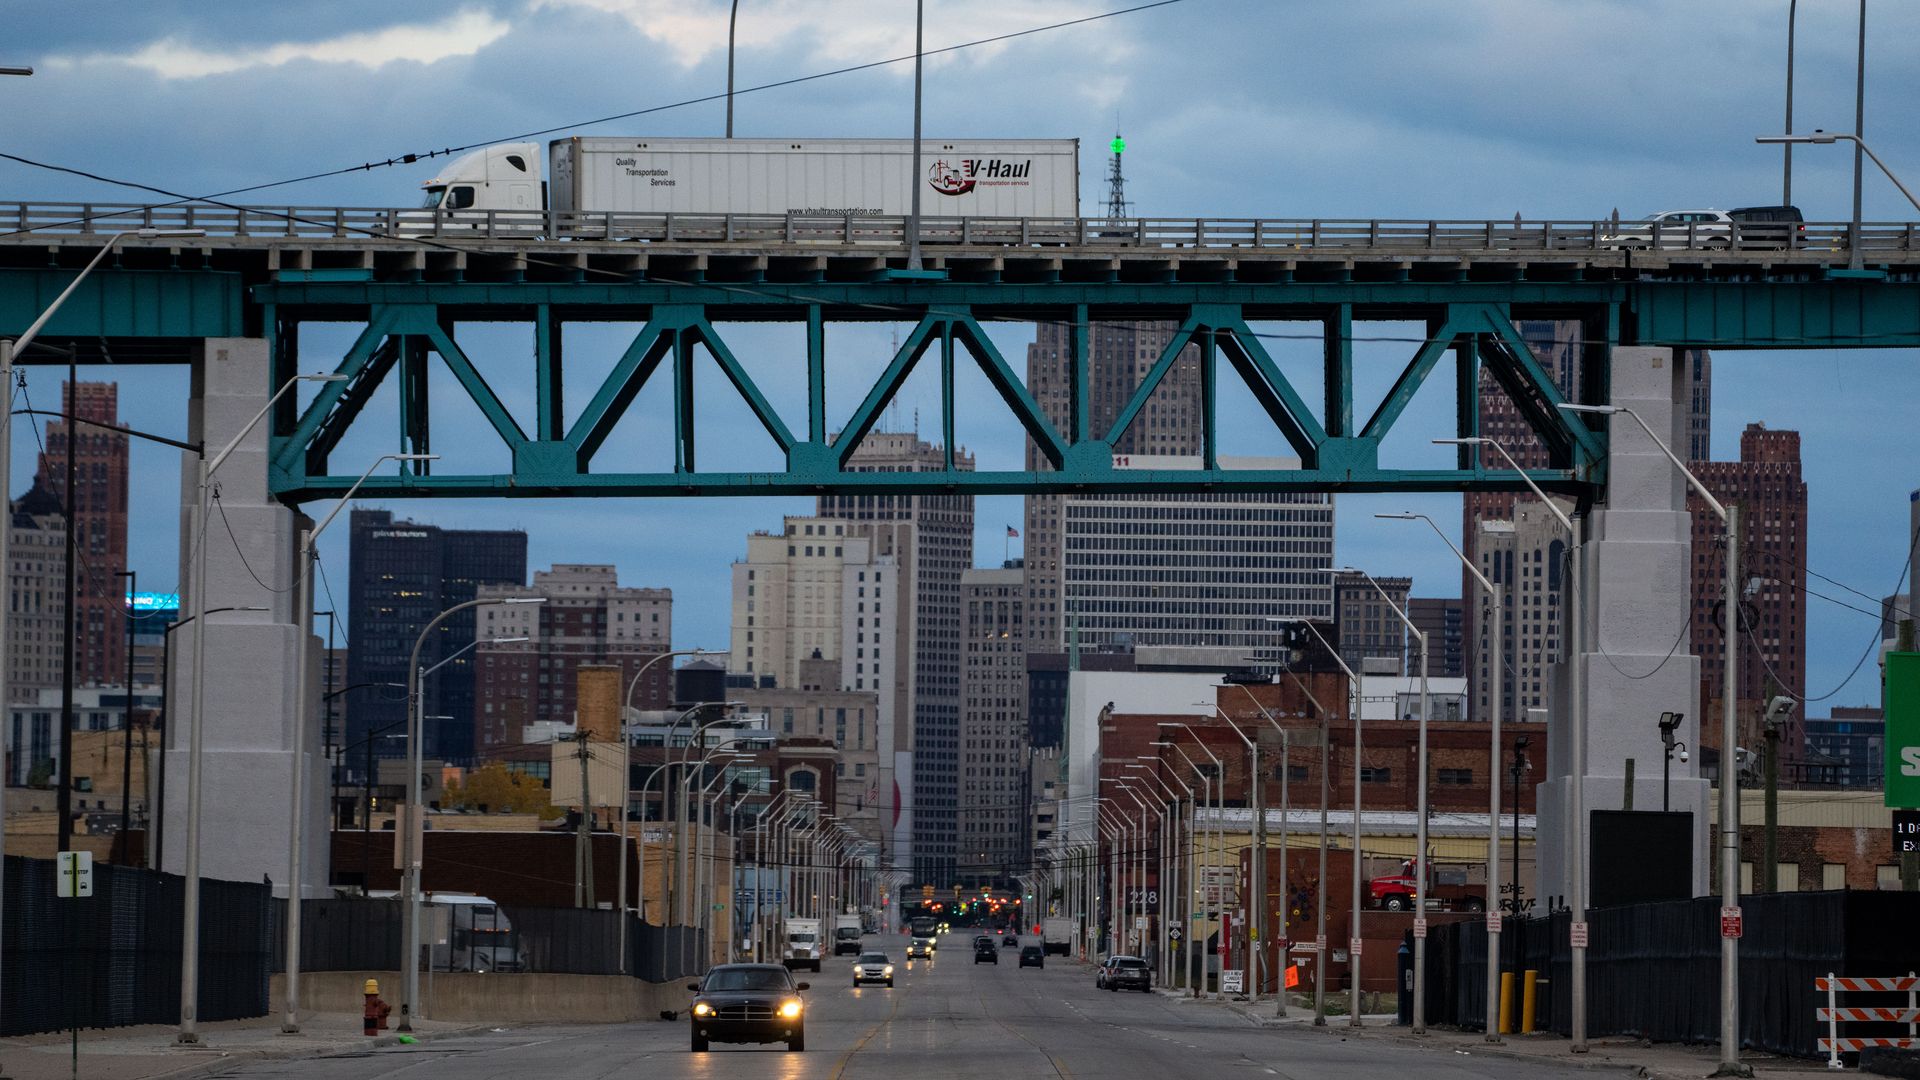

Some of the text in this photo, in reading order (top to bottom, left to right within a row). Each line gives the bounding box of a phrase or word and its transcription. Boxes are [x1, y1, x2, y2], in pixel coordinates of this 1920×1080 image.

[616, 158, 637, 167] Quality
[626, 168, 669, 177] Transportation
[970, 159, 1031, 178] V-Haul
[650, 178, 676, 186] Services
[787, 206, 884, 216] www.vhaultransportation.com
[1897, 823, 1904, 834] 1
[1129, 890, 1158, 905] 228
